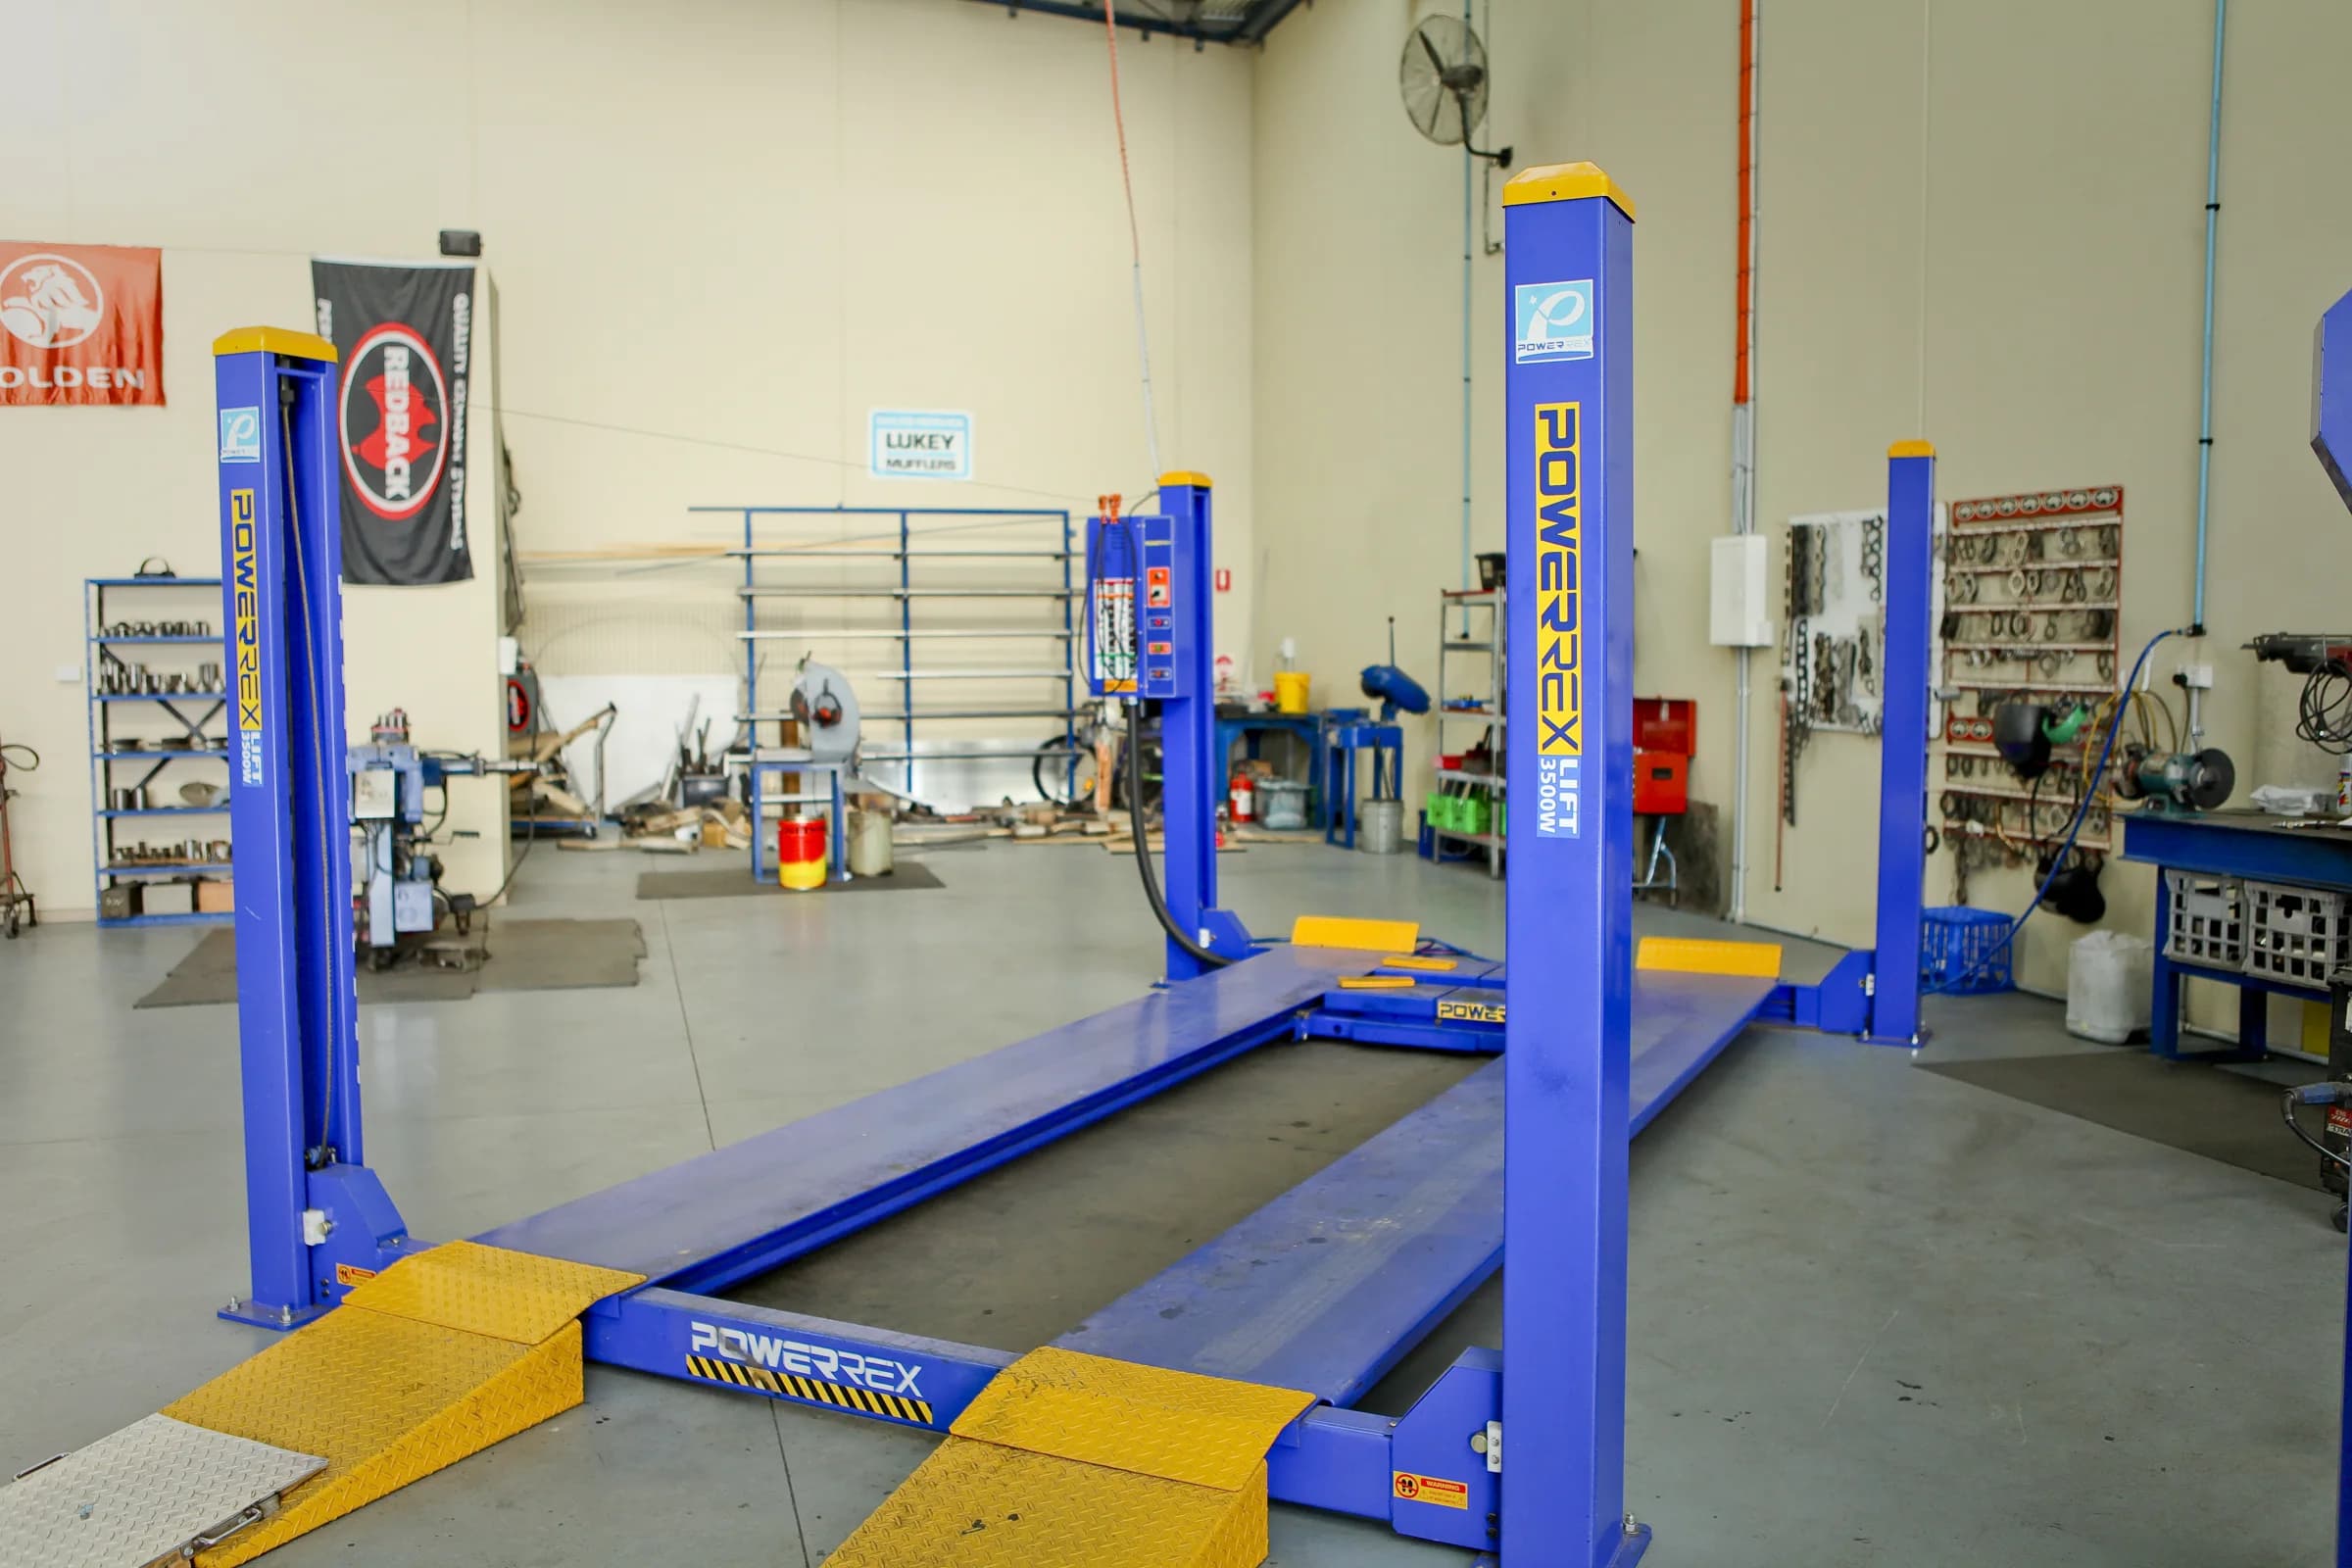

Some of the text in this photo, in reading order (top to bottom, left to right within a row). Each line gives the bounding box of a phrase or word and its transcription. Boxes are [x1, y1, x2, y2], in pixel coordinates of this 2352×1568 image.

[453, 293, 469, 373] QUALITY
[0, 366, 145, 391] OLDEN
[383, 346, 411, 501] REDBACK
[885, 432, 956, 450] LUKEY
[233, 494, 261, 726] POWERREX
[1539, 408, 1579, 752] POWERREX
[241, 731, 252, 784] 3500W
[250, 731, 263, 785] LIFT
[1540, 758, 1556, 833] 3500W
[1559, 759, 1579, 835] LIFT
[1440, 1003, 1506, 1021] POWER
[691, 1321, 924, 1398] POWERREX
